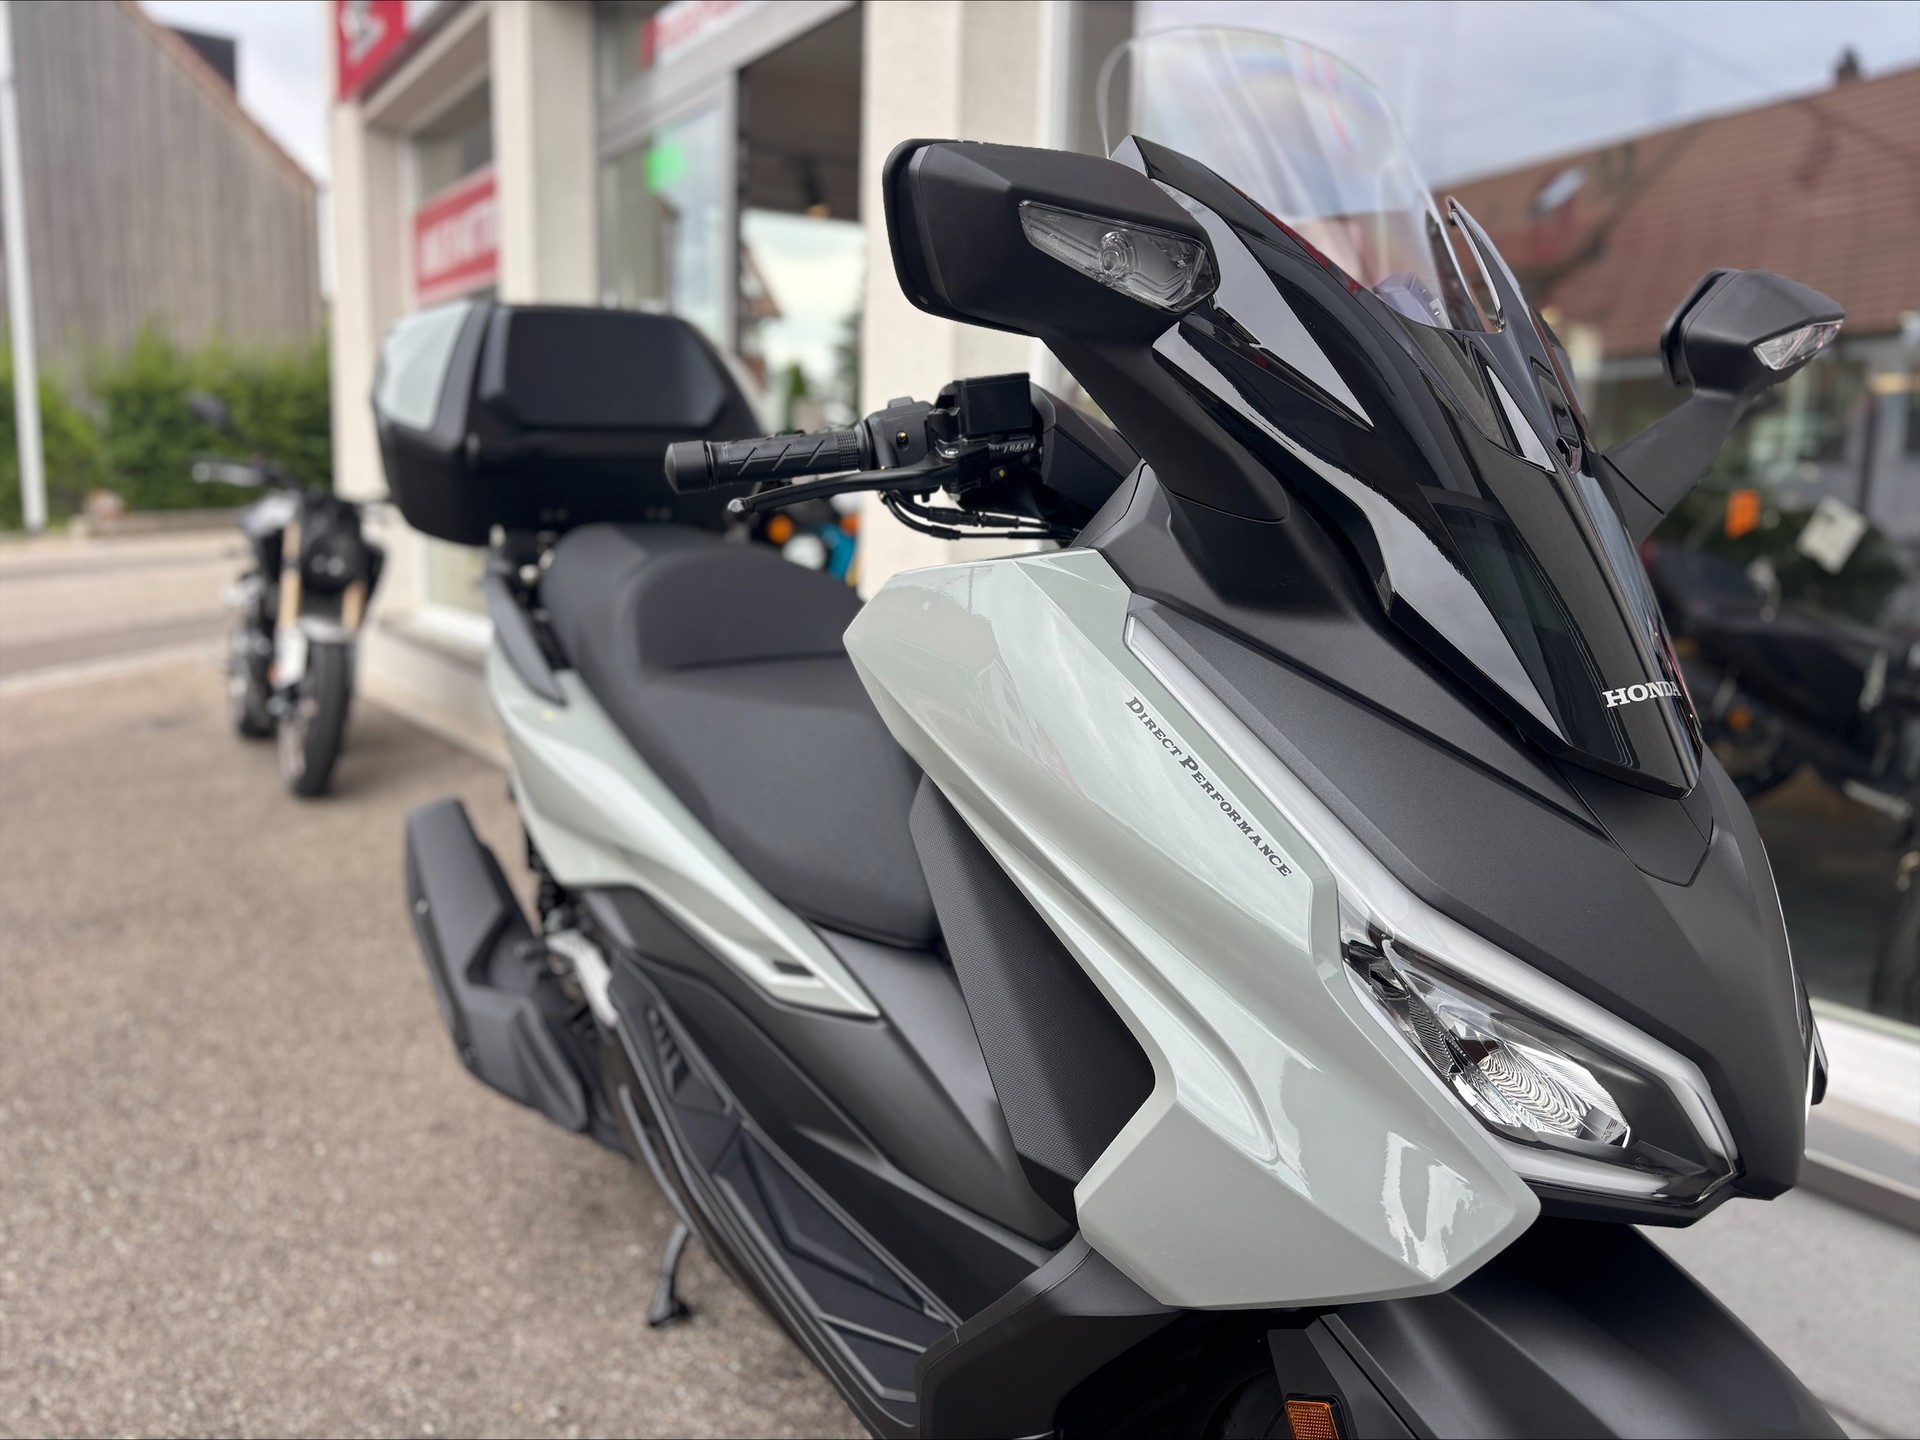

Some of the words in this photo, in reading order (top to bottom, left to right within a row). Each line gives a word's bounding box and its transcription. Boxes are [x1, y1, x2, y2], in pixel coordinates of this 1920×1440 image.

[1602, 681, 1682, 708] HONDA
[1125, 697, 1182, 756] DIRECT
[1179, 755, 1292, 876] PERFORMANCE
